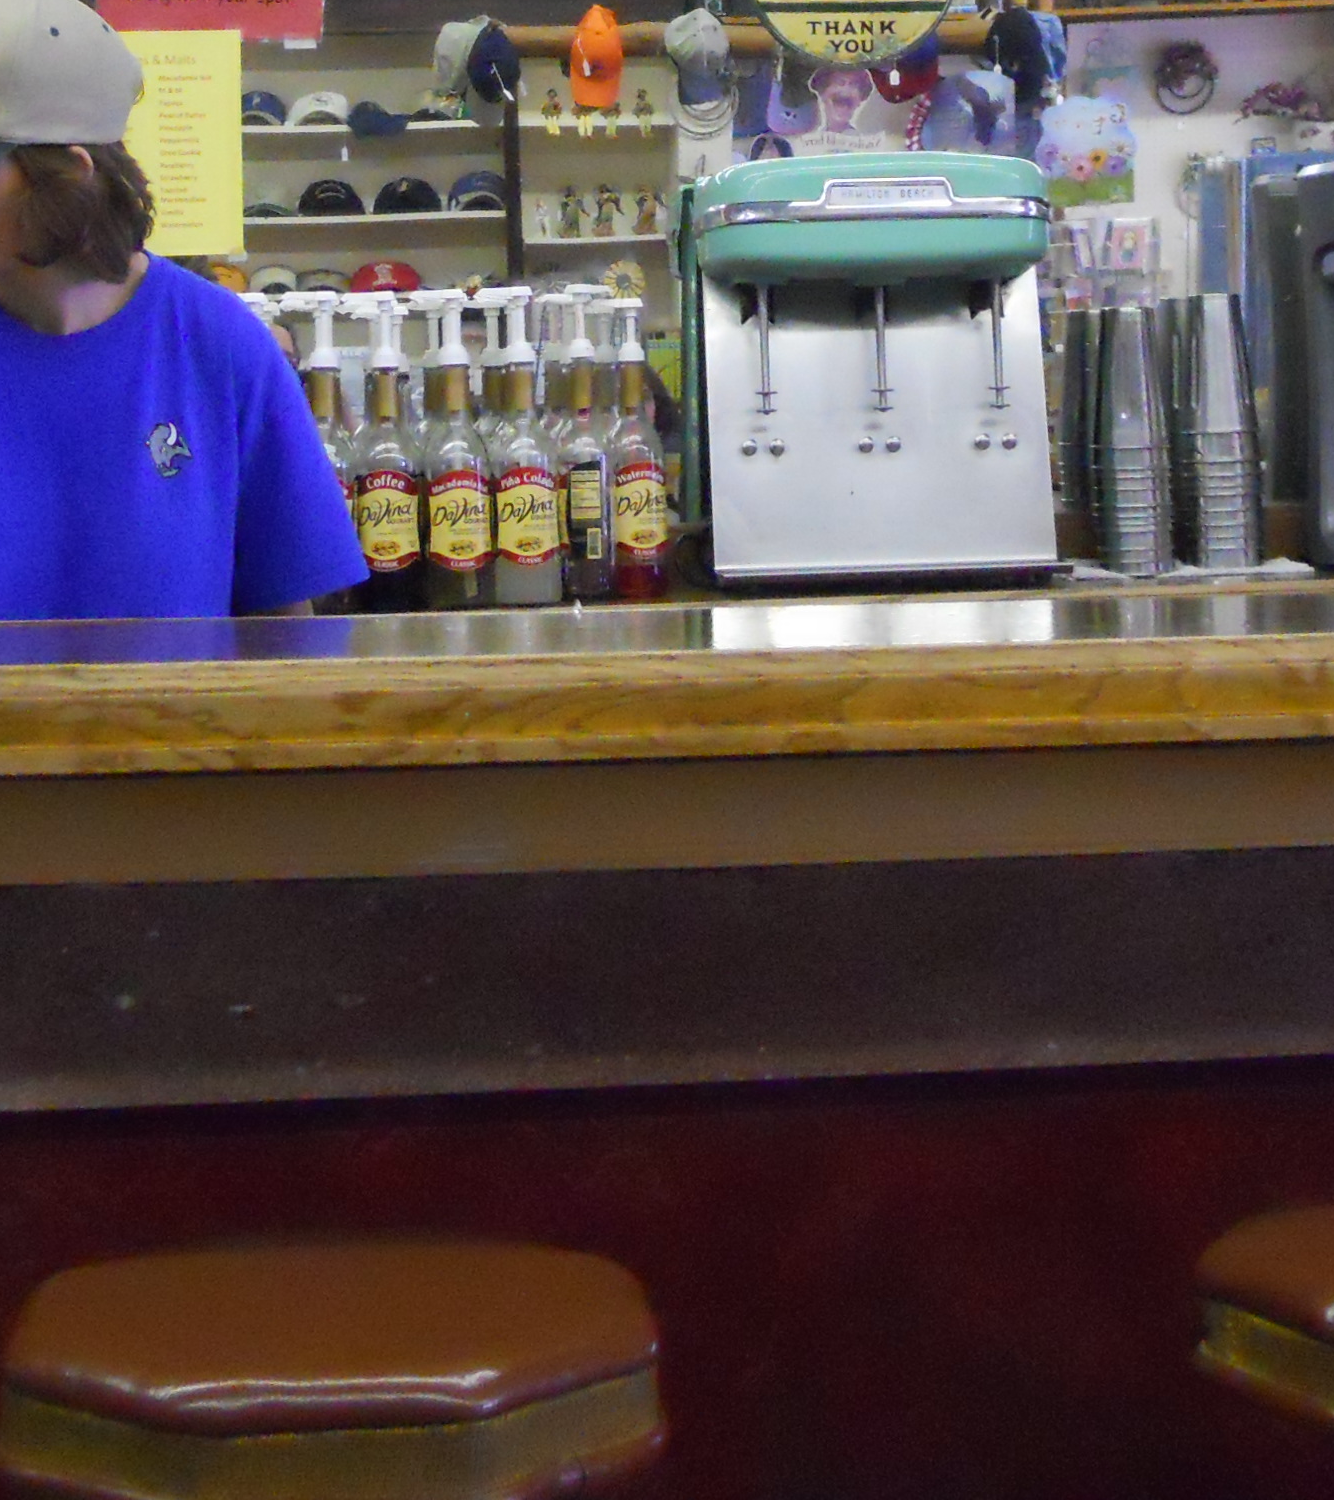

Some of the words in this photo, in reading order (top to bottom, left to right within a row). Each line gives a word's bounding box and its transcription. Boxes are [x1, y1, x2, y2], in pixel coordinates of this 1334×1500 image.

[805, 20, 898, 36] THANK
[829, 39, 875, 53] YOU
[900, 188, 935, 199] BEACH
[365, 473, 406, 490] Coffee
